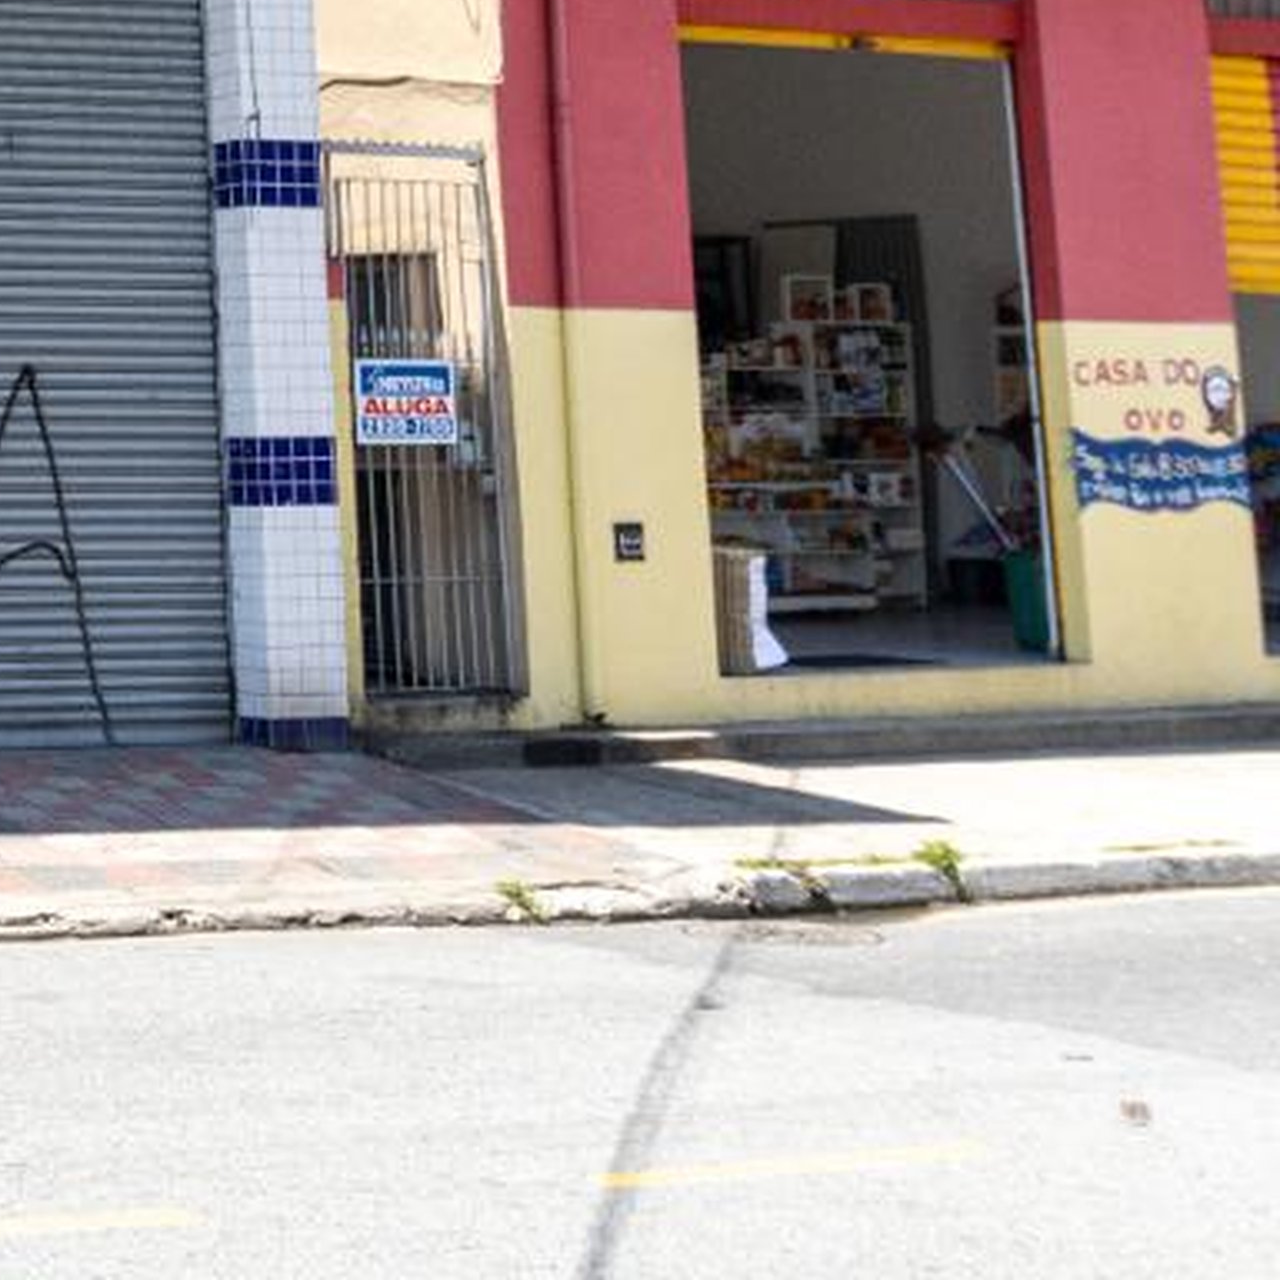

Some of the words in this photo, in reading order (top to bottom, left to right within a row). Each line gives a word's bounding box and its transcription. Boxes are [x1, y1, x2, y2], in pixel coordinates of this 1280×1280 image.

[1073, 359, 1149, 386] CASA
[1163, 358, 1201, 384] DO
[364, 397, 449, 415] ALUGA
[1122, 409, 1187, 432] OVO
